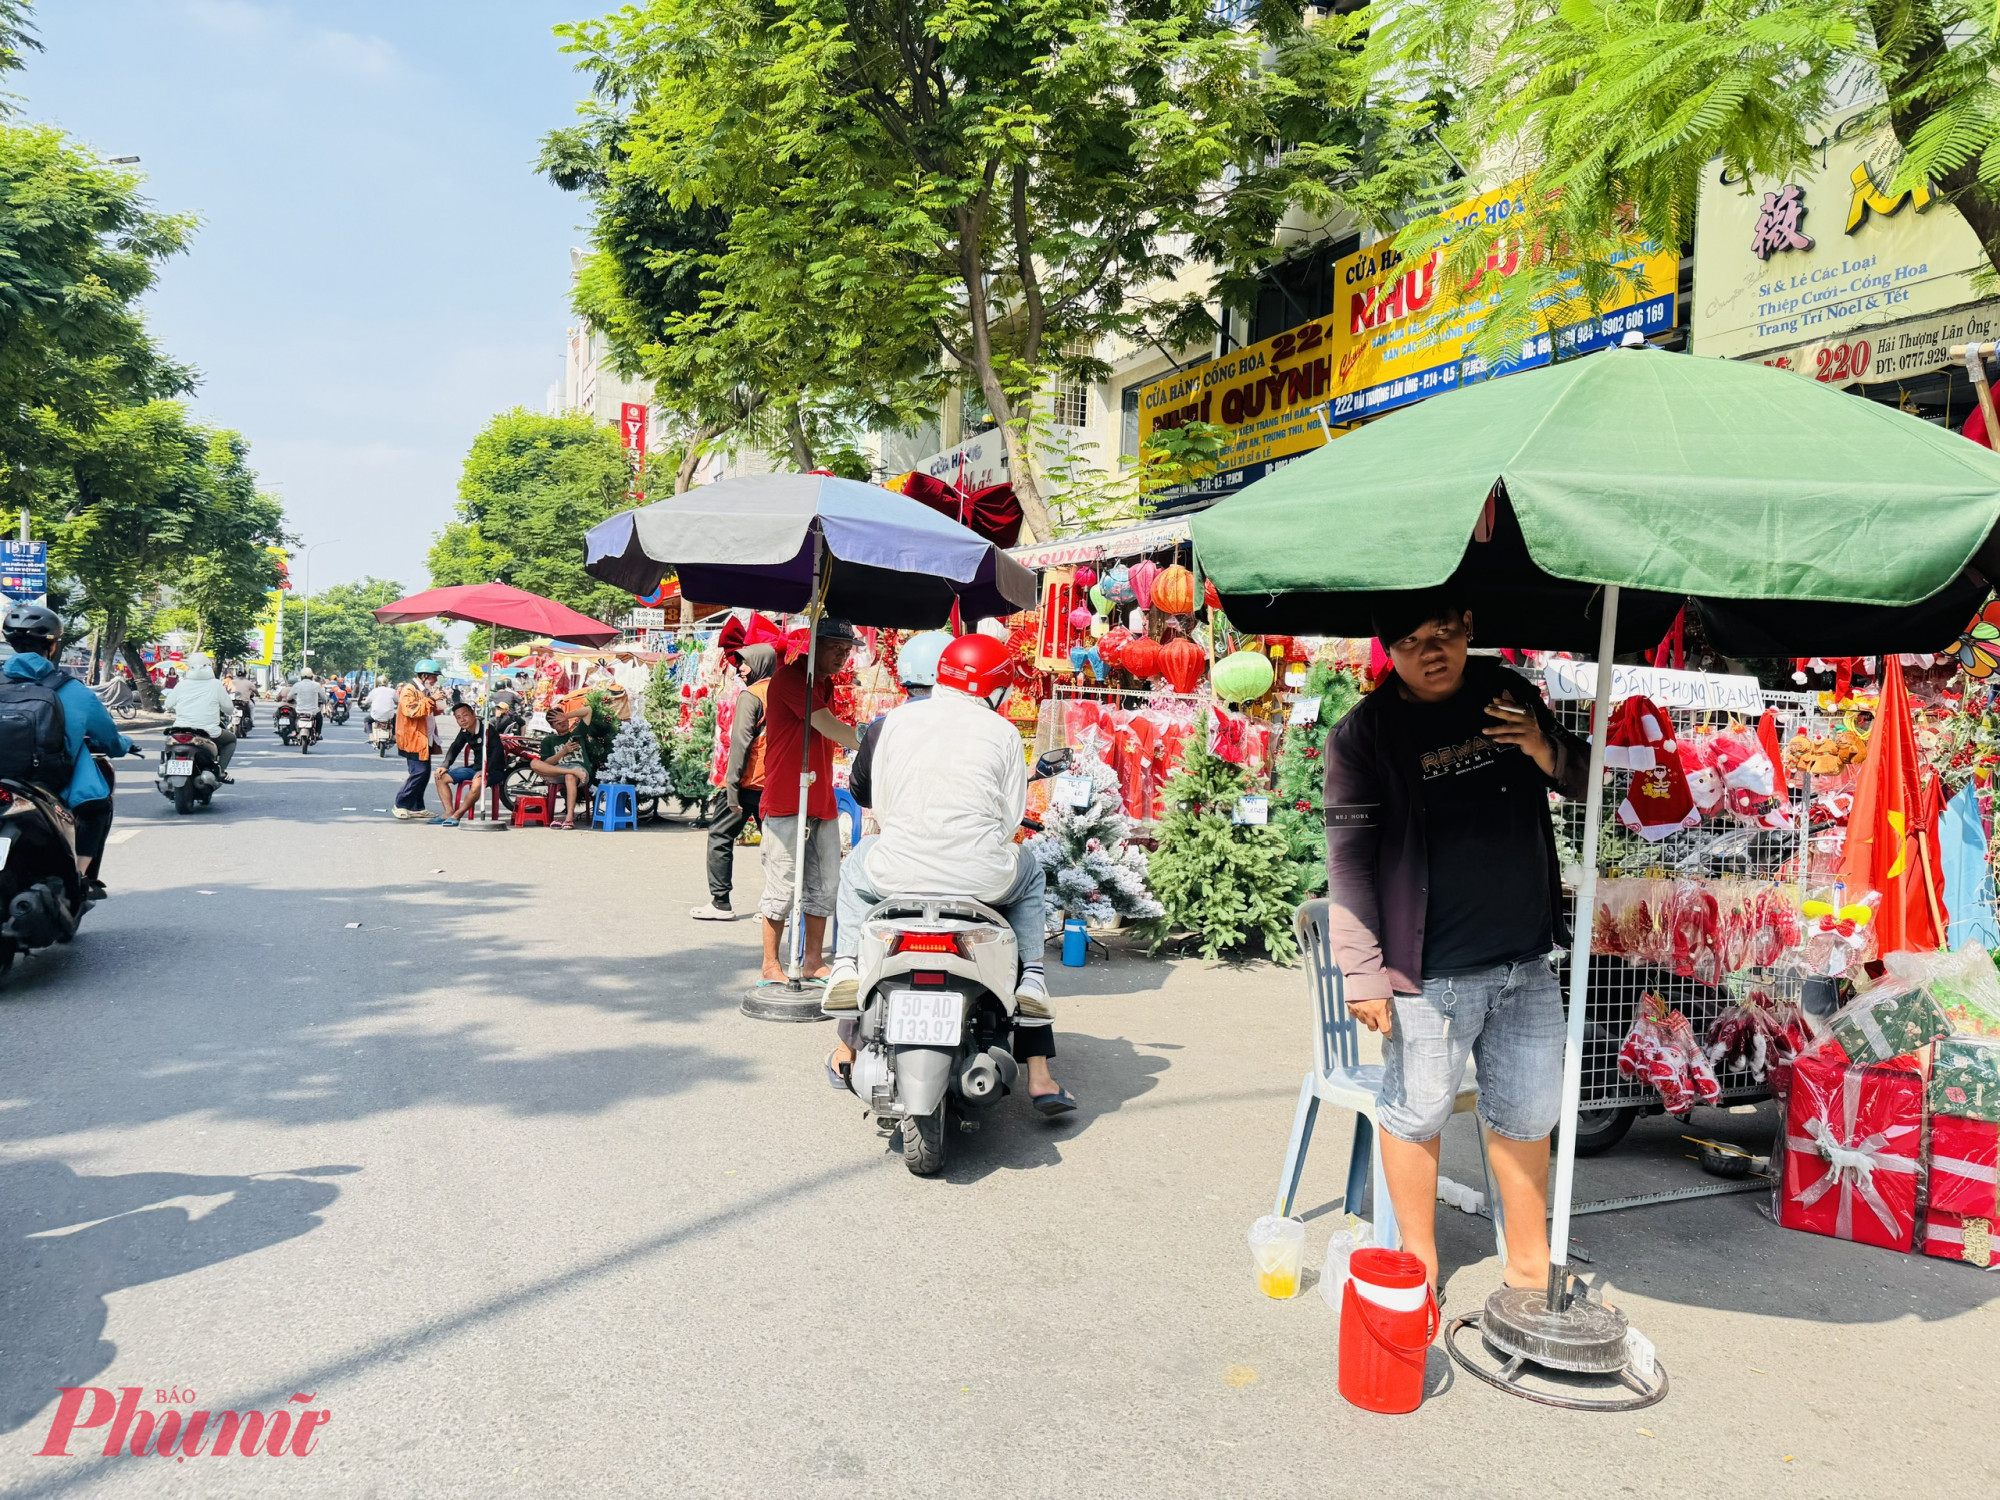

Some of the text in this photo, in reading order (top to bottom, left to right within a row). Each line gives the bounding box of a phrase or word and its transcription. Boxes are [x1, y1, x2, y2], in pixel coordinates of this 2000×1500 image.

[1346, 253, 1376, 285] CỬA
[1484, 194, 1526, 225] HOA
[1757, 297, 1799, 318] Thiệp
[1802, 285, 1838, 306] Cưới
[1850, 271, 1892, 293] Cổng
[1894, 263, 1929, 282] Hoa
[1774, 280, 1787, 293] &
[1811, 266, 1838, 283] Các
[1842, 254, 1877, 275] Loại
[1351, 252, 1442, 336] NHƯ
[1757, 319, 1798, 338] Trang
[1801, 309, 1824, 327] Trí
[1865, 296, 1880, 310] &
[1884, 286, 1910, 306] Tết
[1626, 309, 1644, 329] 606
[1646, 302, 1665, 323] 169
[1877, 337, 1896, 354] Hải
[1899, 330, 1940, 349] Thượng
[1941, 324, 1964, 341] Lãn
[1967, 315, 1991, 337] Ông
[1146, 351, 1267, 410] CỬA HÀNG CỔNG HOA
[1815, 339, 1872, 383] 220
[1876, 357, 1896, 375] ĐT:
[1221, 353, 1333, 425] QUỲNH
[1334, 394, 1354, 416] 222
[1364, 384, 1390, 407] THƯỢNG
[1390, 381, 1404, 399] LÃN
[1404, 376, 1419, 395] ÔNG
[1423, 372, 1438, 389] P.14
[1443, 366, 1456, 384] Q.5
[1256, 417, 1279, 434] TRANG
[1262, 431, 1287, 445] TRUNG
[1558, 662, 1590, 694] CÓ
[902, 997, 952, 1019] 50-AD
[896, 1019, 955, 1042] 133.97
